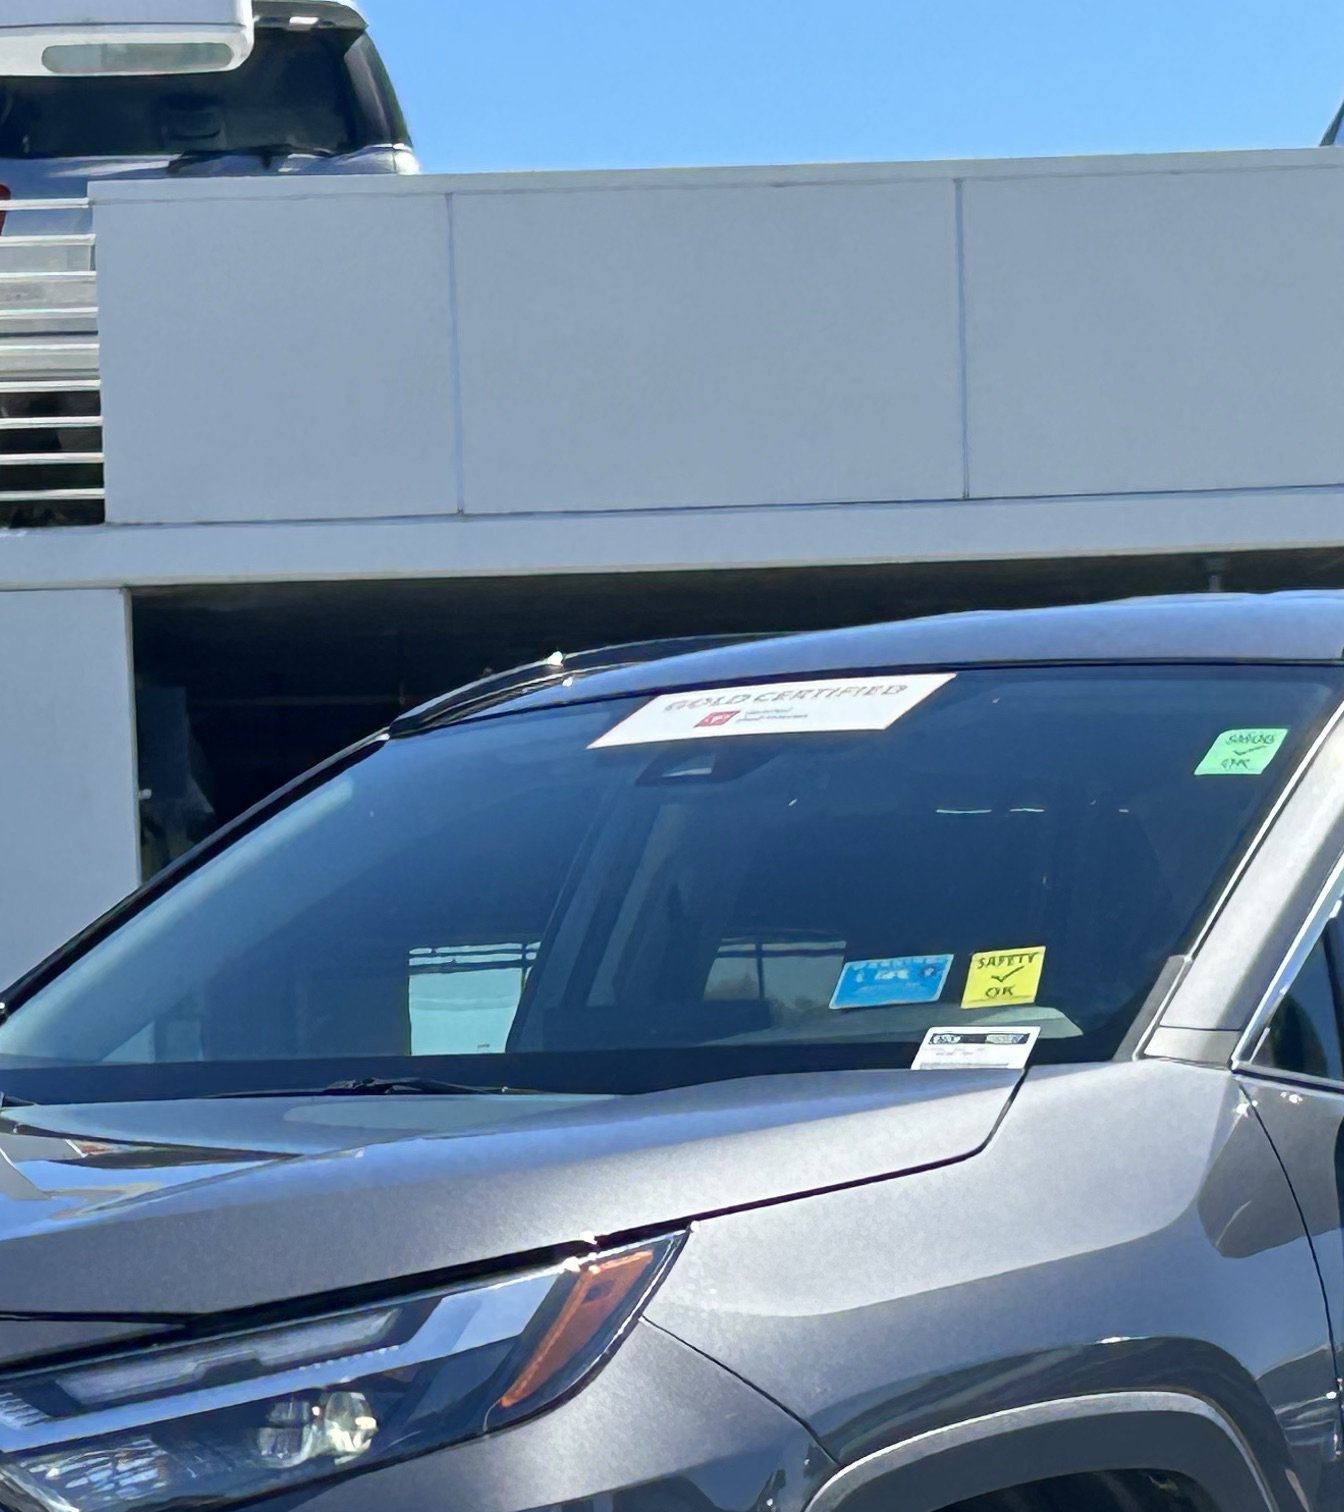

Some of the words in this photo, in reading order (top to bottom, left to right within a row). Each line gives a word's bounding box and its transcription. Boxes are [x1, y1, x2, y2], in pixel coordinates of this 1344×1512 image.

[753, 684, 909, 703] CERTIFIED
[976, 951, 1040, 970] SAFETY
[984, 984, 1016, 999] OK
